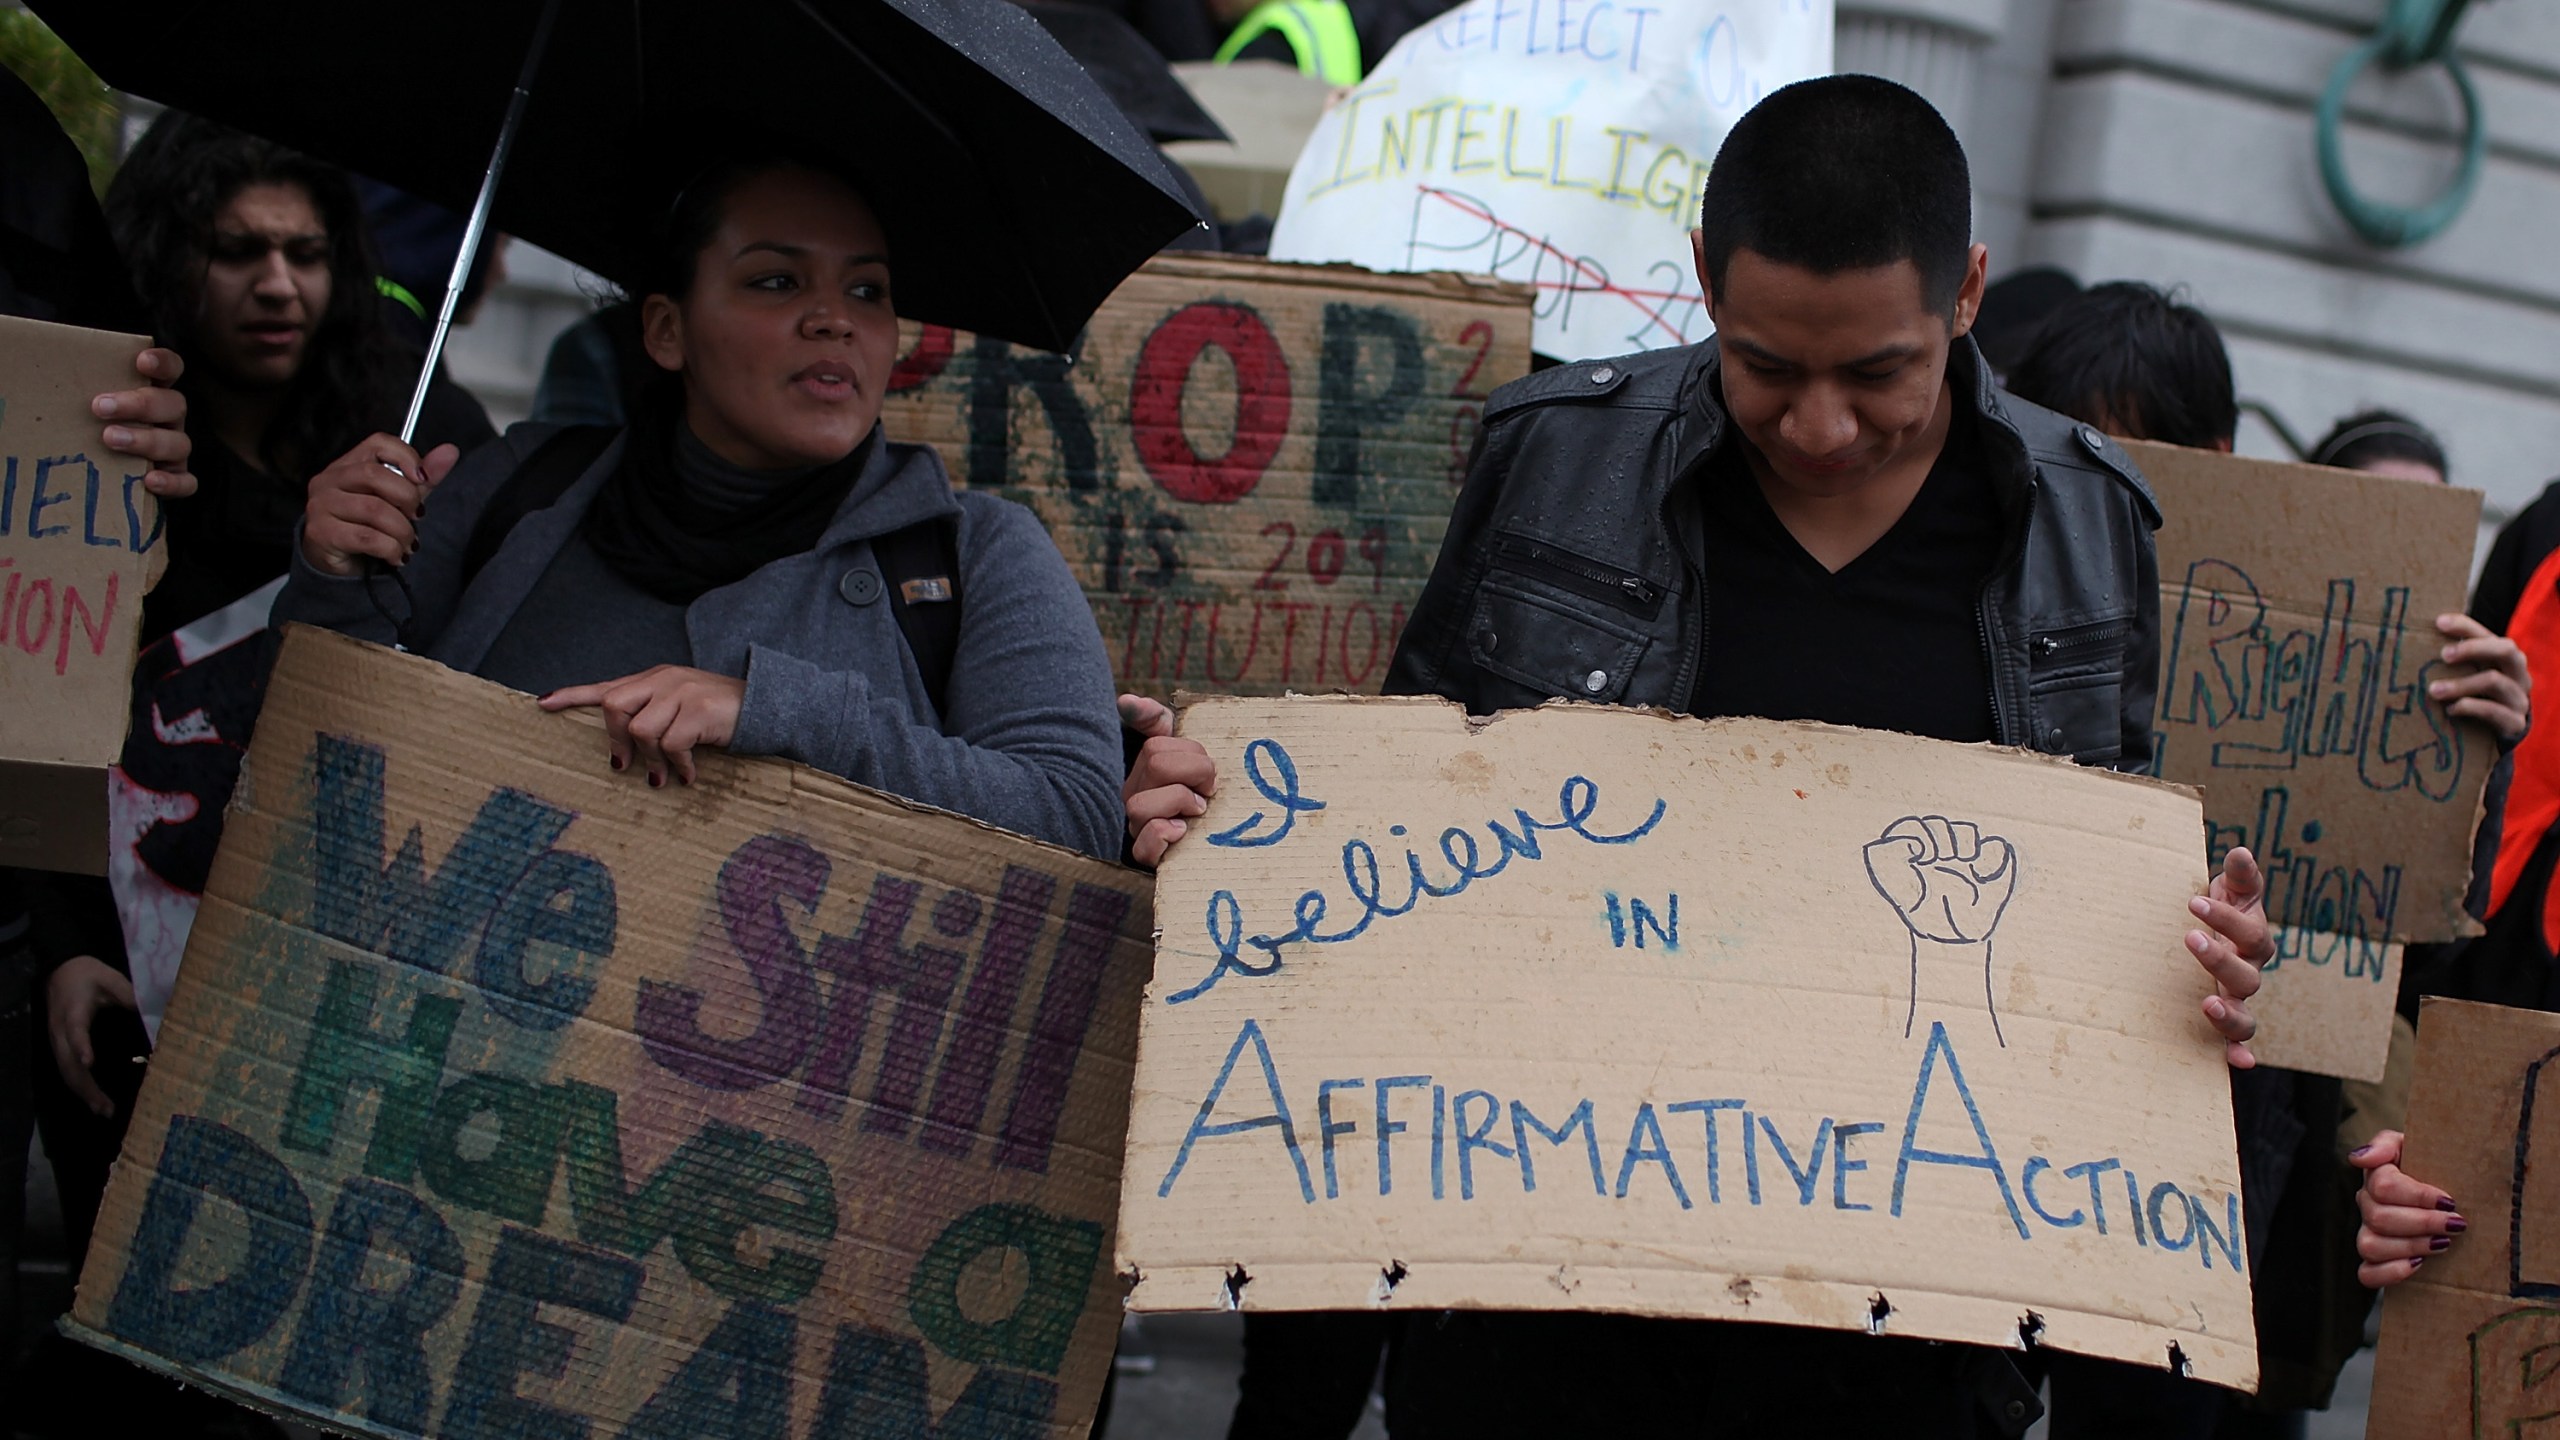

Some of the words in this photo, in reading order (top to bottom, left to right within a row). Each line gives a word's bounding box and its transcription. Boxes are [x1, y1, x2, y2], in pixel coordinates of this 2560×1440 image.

[1120, 597, 1406, 688] TITUTIO
[1254, 520, 1388, 593] 209
[1207, 738, 1327, 847] I
[2162, 558, 2464, 801] Rights
[312, 730, 617, 1032] We
[632, 832, 1132, 1175] Still
[1165, 774, 1667, 1005] believe
[1602, 890, 1680, 950] IN
[280, 957, 840, 1305] Have
[910, 1201, 1106, 1377] a
[1158, 1018, 1885, 1211] AFFIRMATIVE
[1890, 1020, 2244, 1274] ACTION
